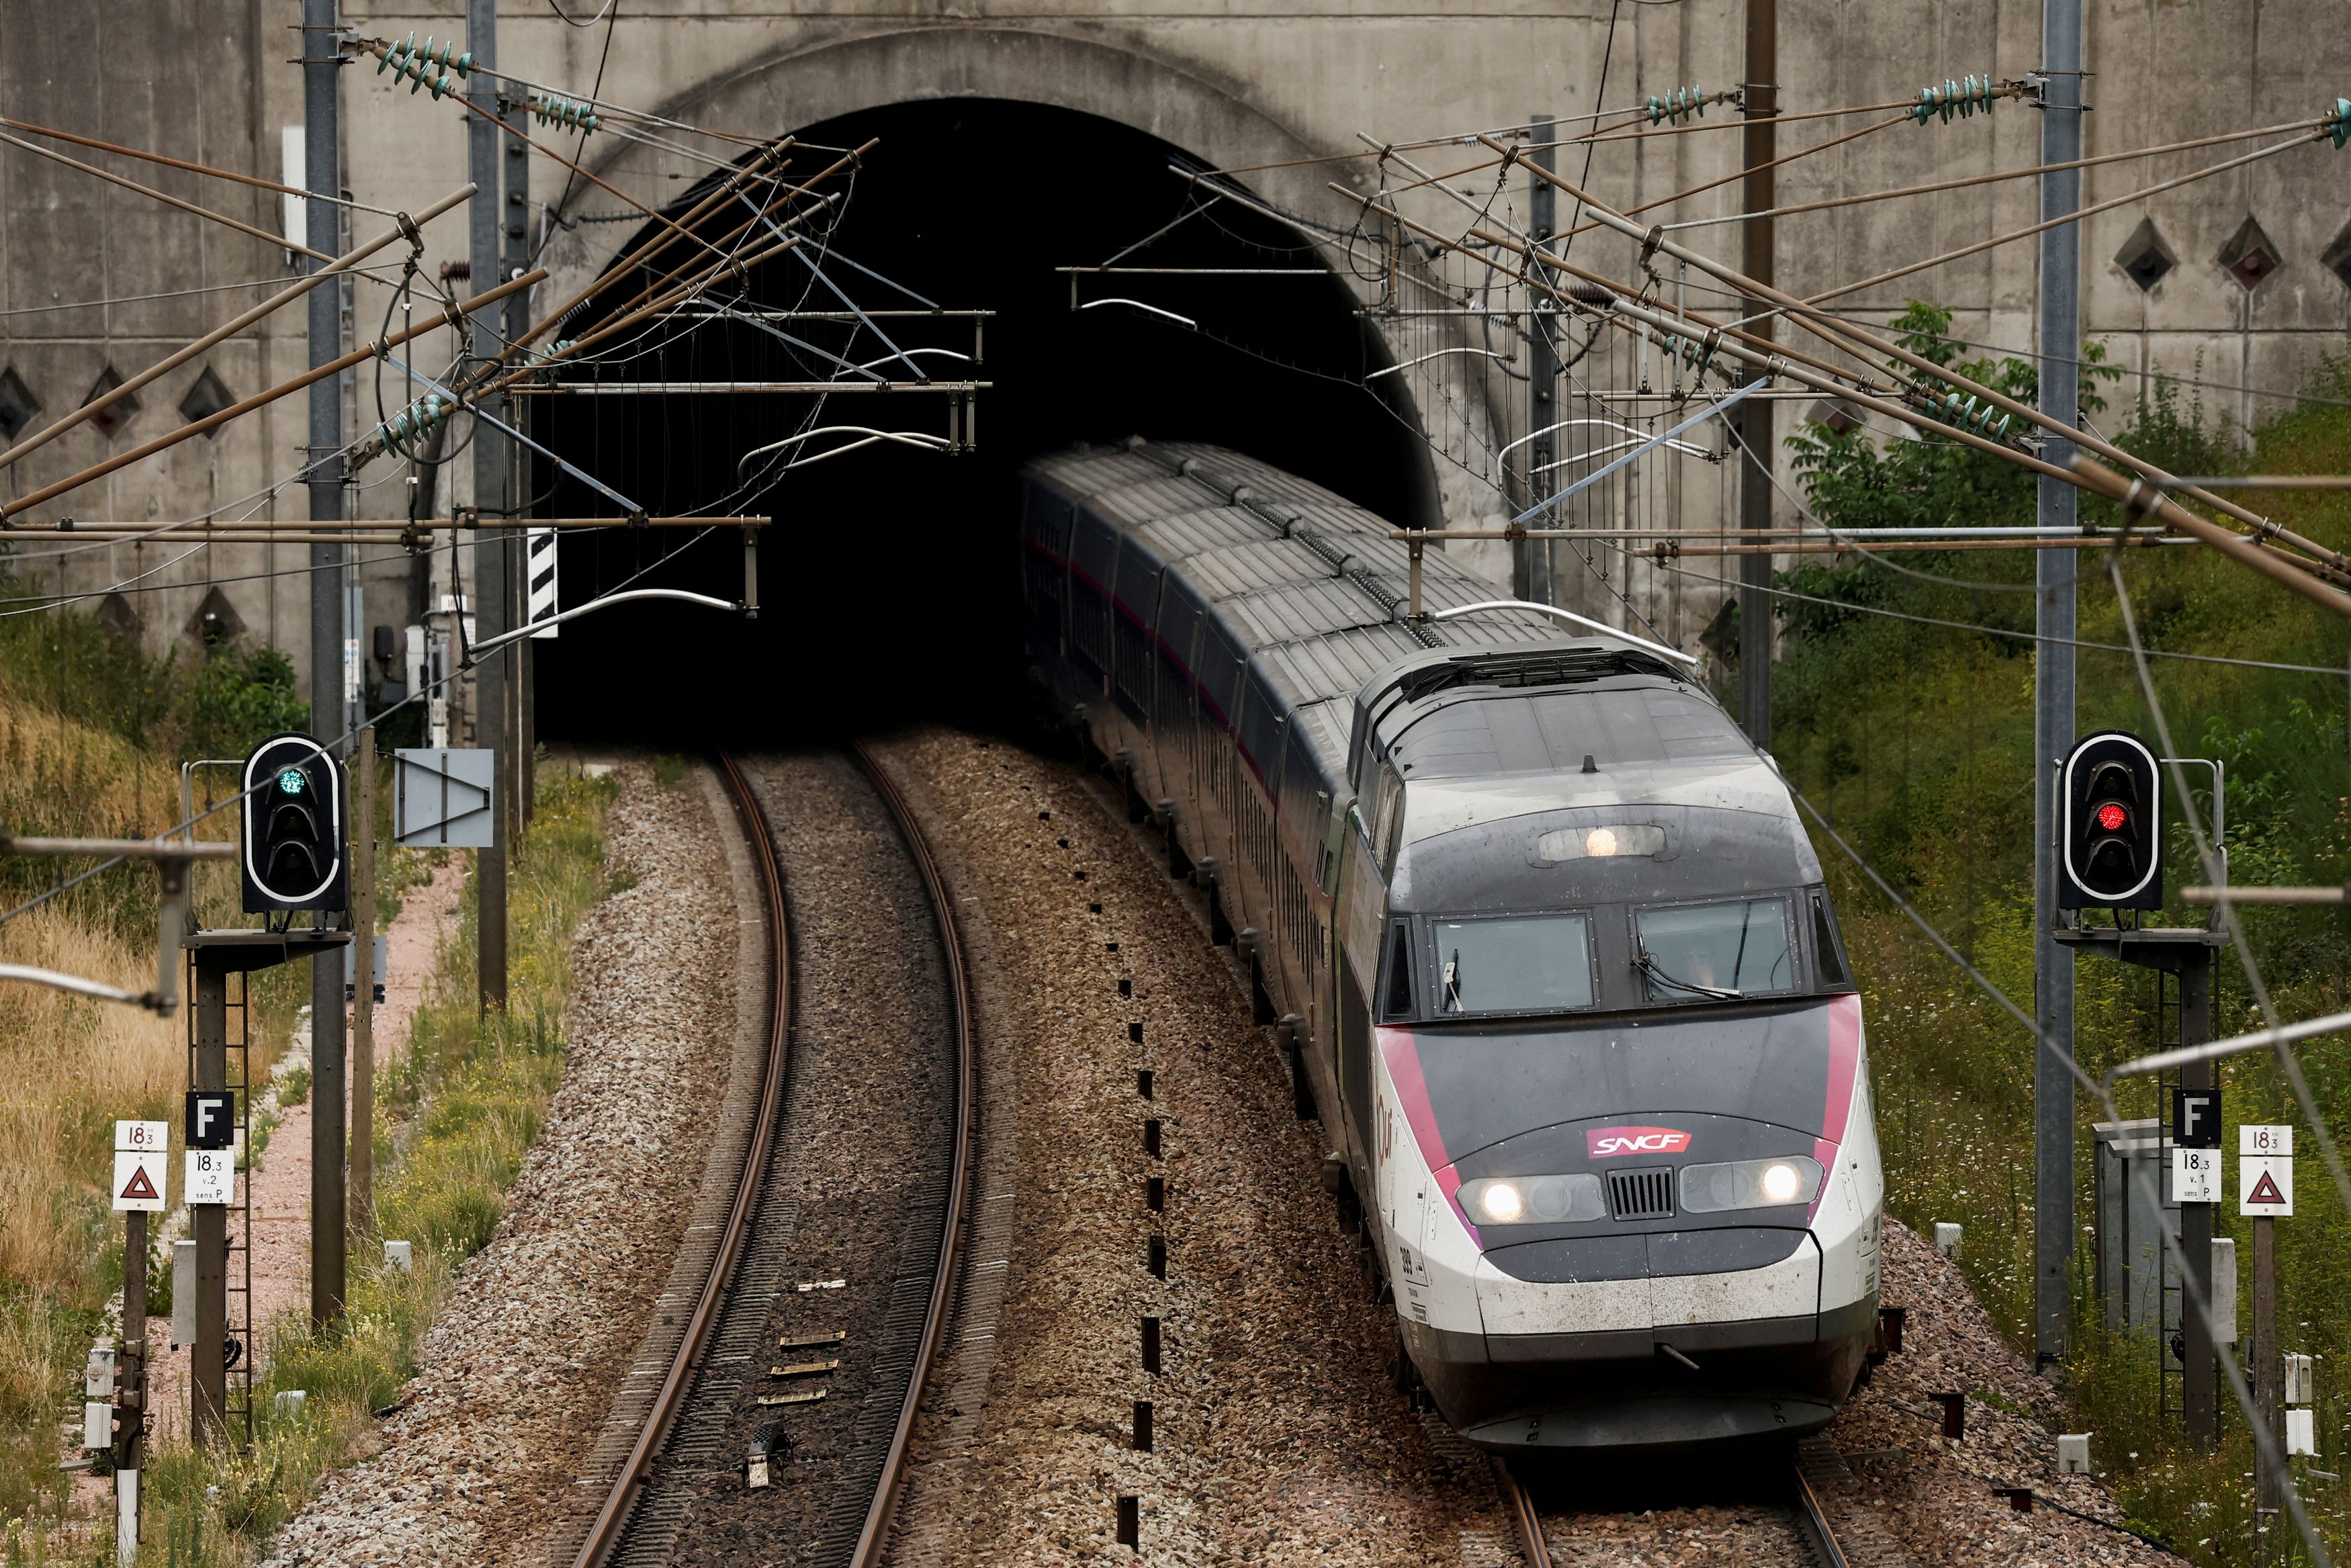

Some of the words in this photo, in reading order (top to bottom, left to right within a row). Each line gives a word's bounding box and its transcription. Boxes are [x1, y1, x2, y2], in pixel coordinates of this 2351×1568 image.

[197, 1099, 222, 1138] F
[2184, 1097, 2209, 1136] F
[1593, 1134, 1685, 1154] SNCF
[197, 1155, 222, 1171] 18.3
[2184, 1154, 2209, 1170] 18.3
[216, 1189, 222, 1199] P
[2203, 1187, 2210, 1197] P
